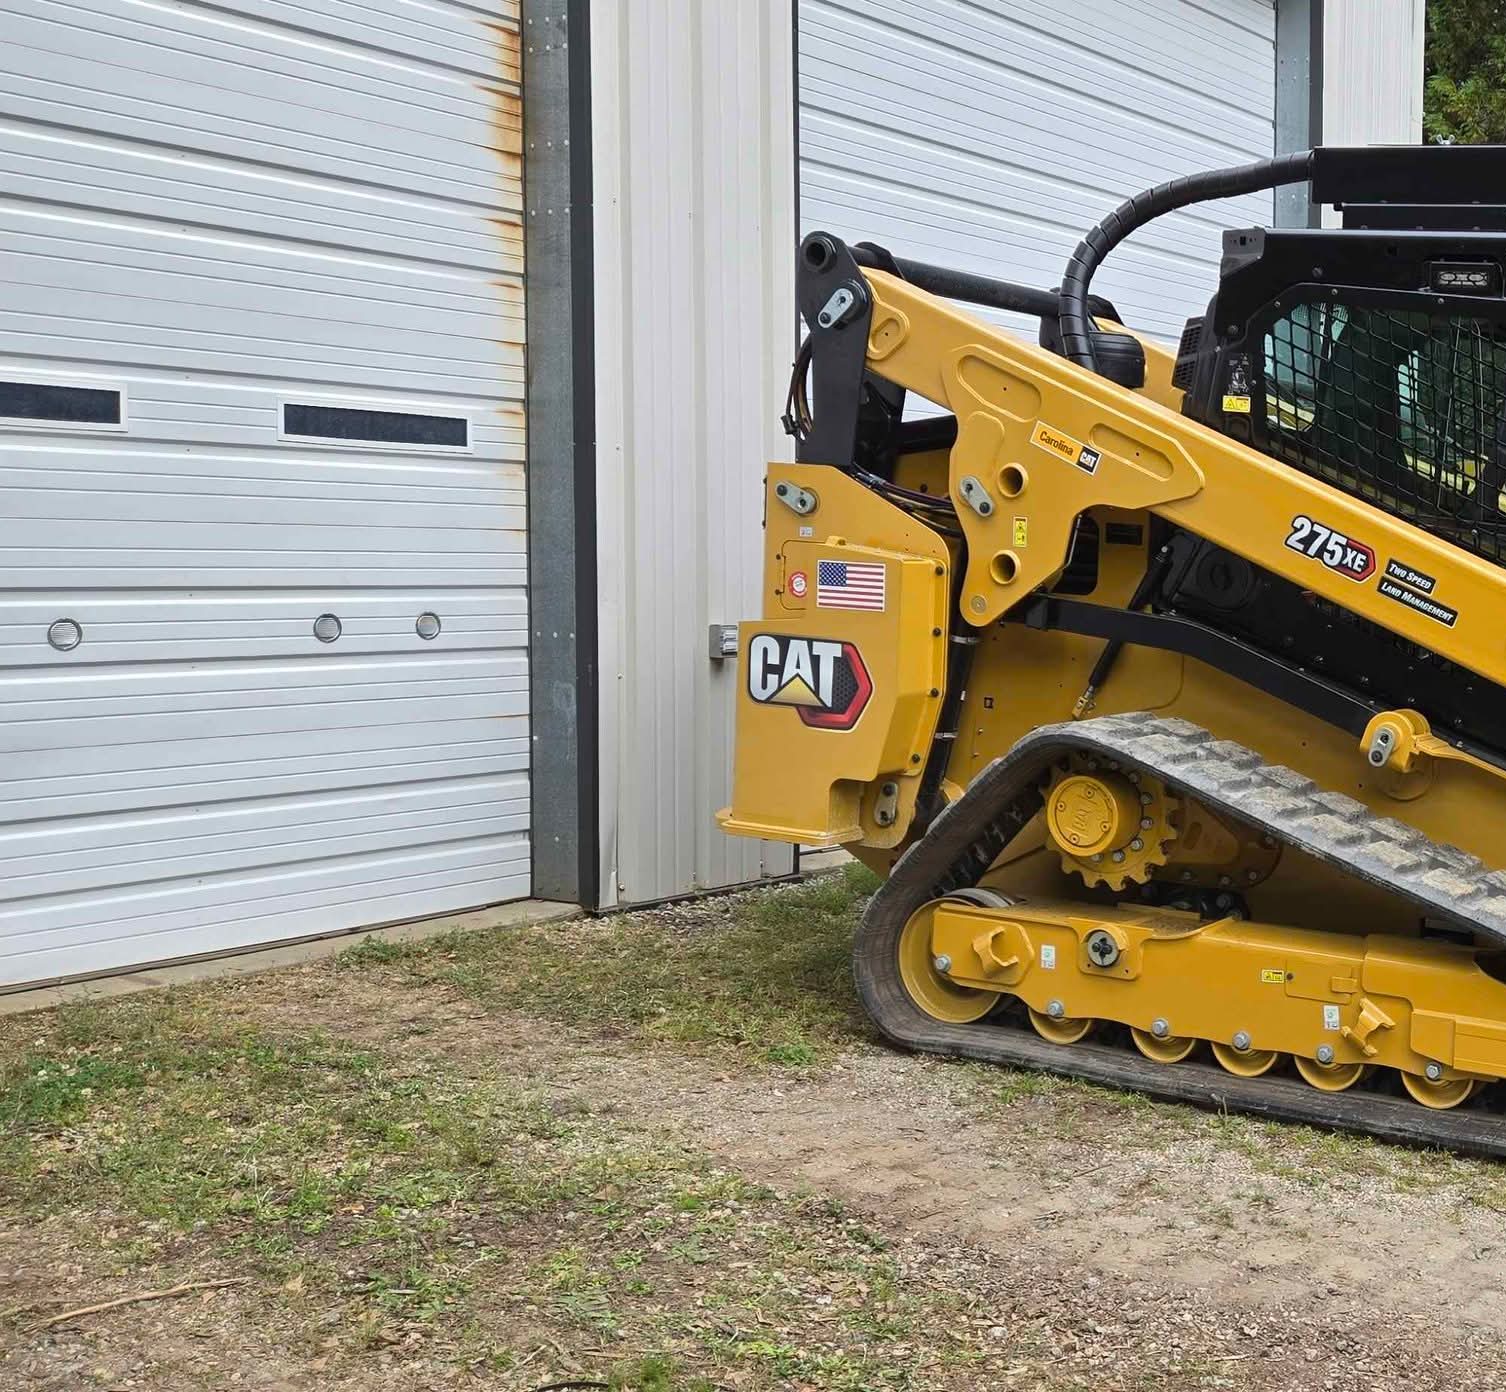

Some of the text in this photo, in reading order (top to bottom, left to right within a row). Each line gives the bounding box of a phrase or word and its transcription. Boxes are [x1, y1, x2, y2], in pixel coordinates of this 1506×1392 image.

[1039, 430, 1097, 468] Carolina CAT
[1389, 563, 1432, 590] TWO SPEED
[1381, 582, 1454, 622] LAND MANAGEMENT
[750, 635, 843, 708] CAT
